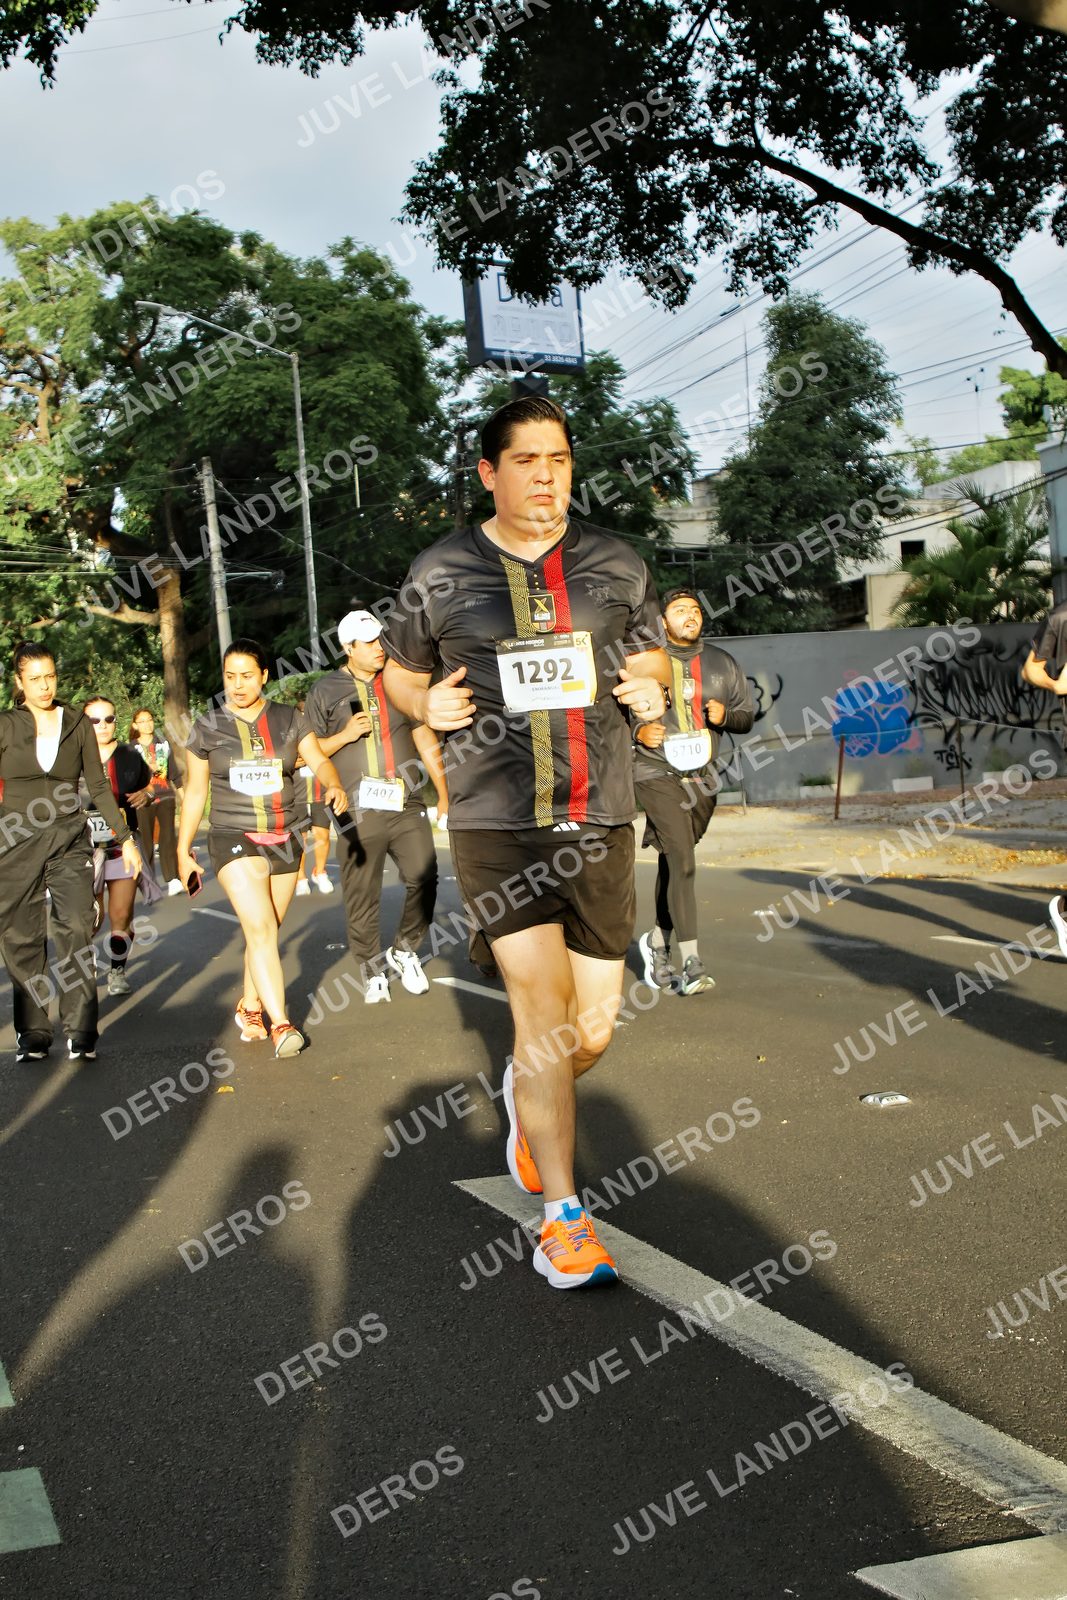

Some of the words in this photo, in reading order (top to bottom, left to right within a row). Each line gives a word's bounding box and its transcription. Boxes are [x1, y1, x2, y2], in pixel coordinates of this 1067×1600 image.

[512, 657, 575, 684] 1292
[672, 743, 701, 757] 5710
[366, 787, 394, 800] 7407
